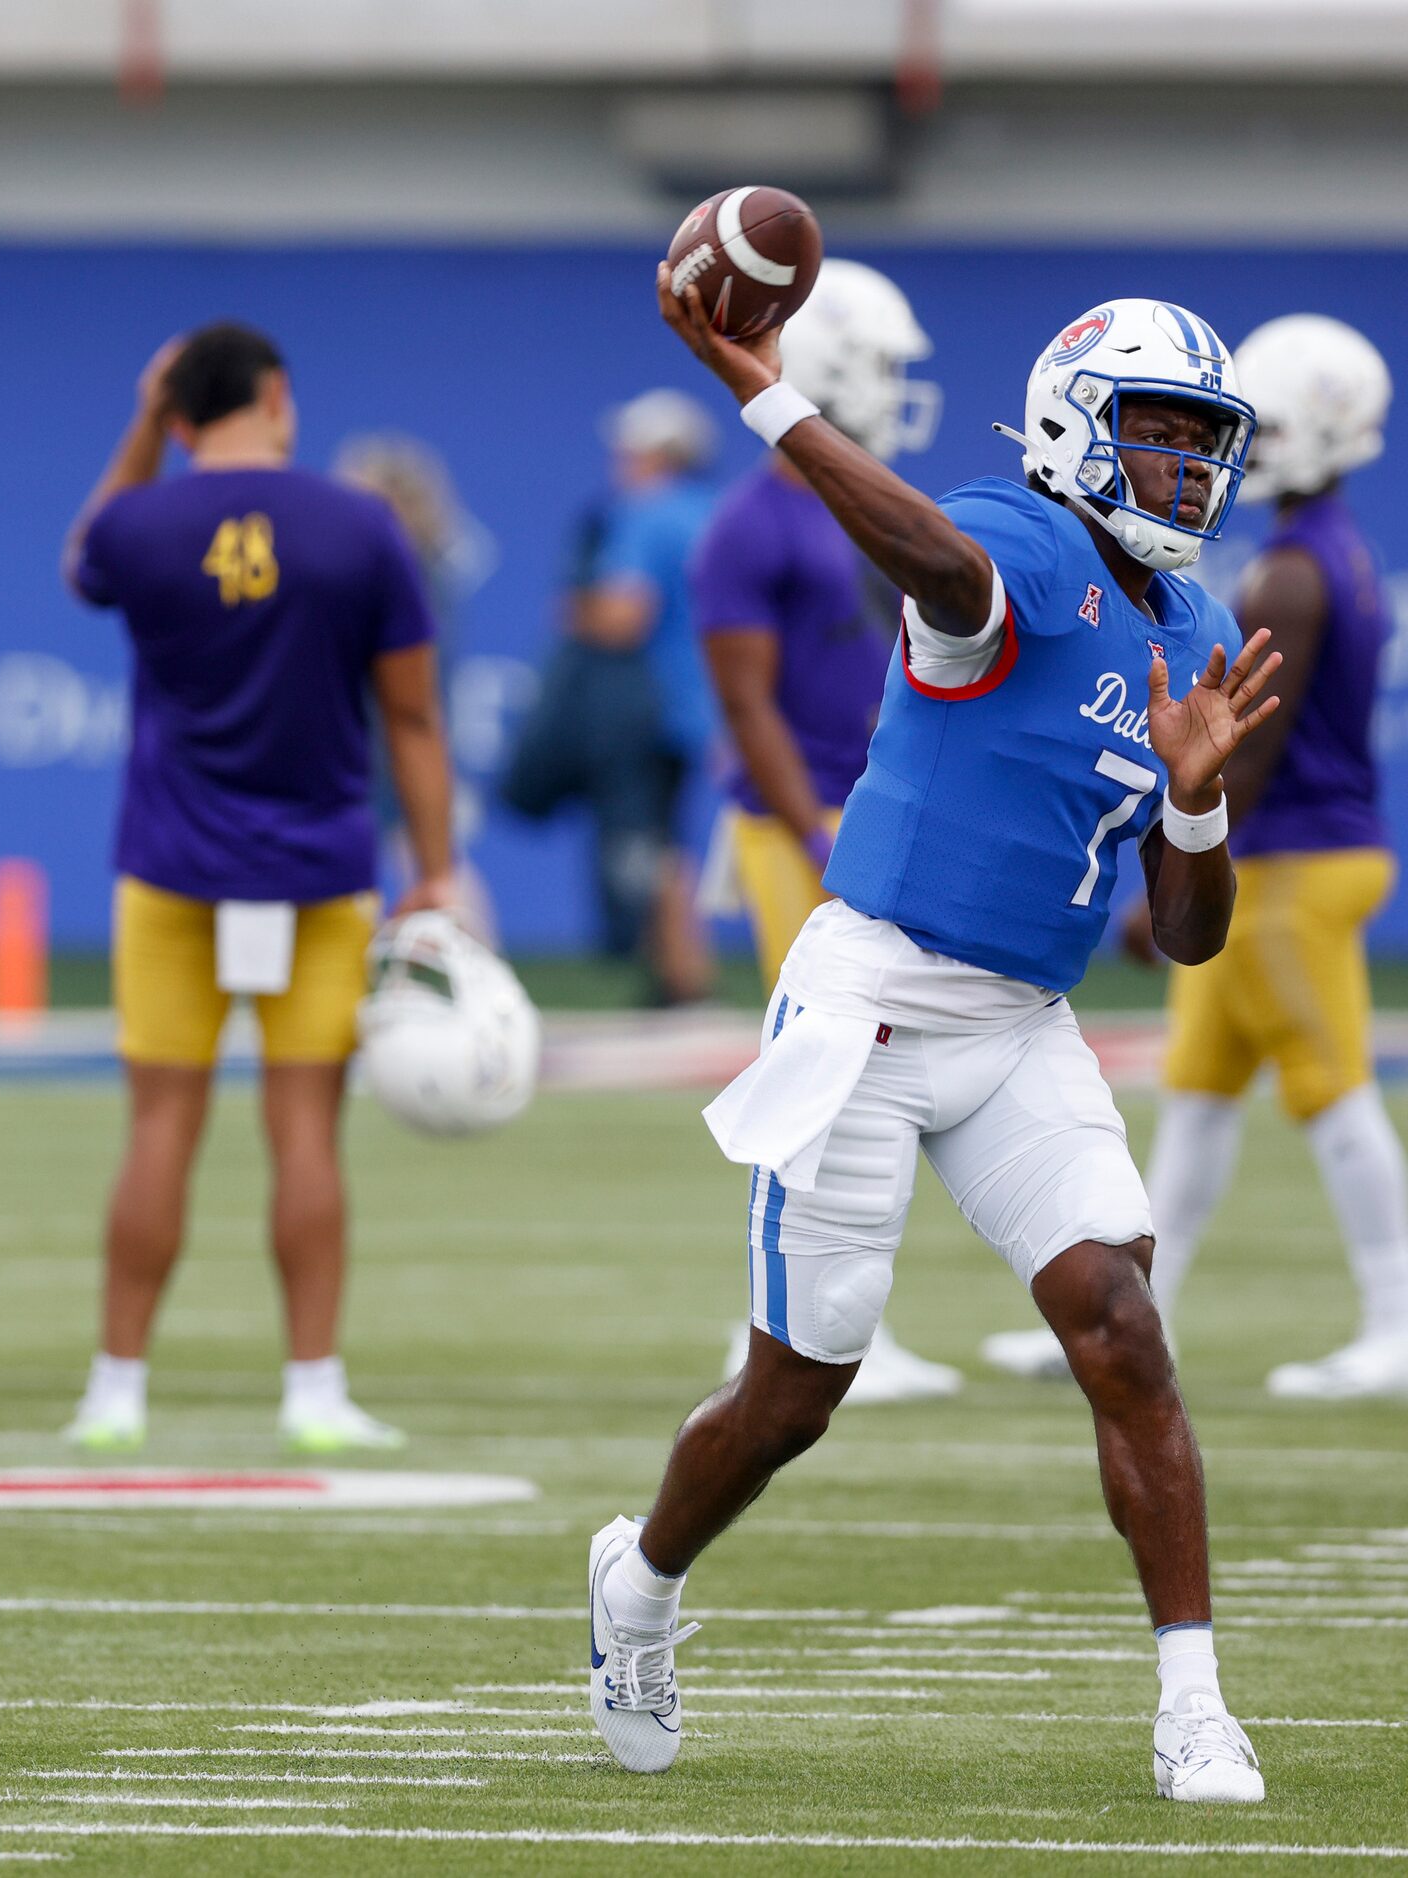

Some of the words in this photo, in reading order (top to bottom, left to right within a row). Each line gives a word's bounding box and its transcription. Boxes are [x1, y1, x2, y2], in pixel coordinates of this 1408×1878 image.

[1200, 371, 1222, 389] 214
[200, 511, 279, 608] 48
[1070, 749, 1158, 907] 7
